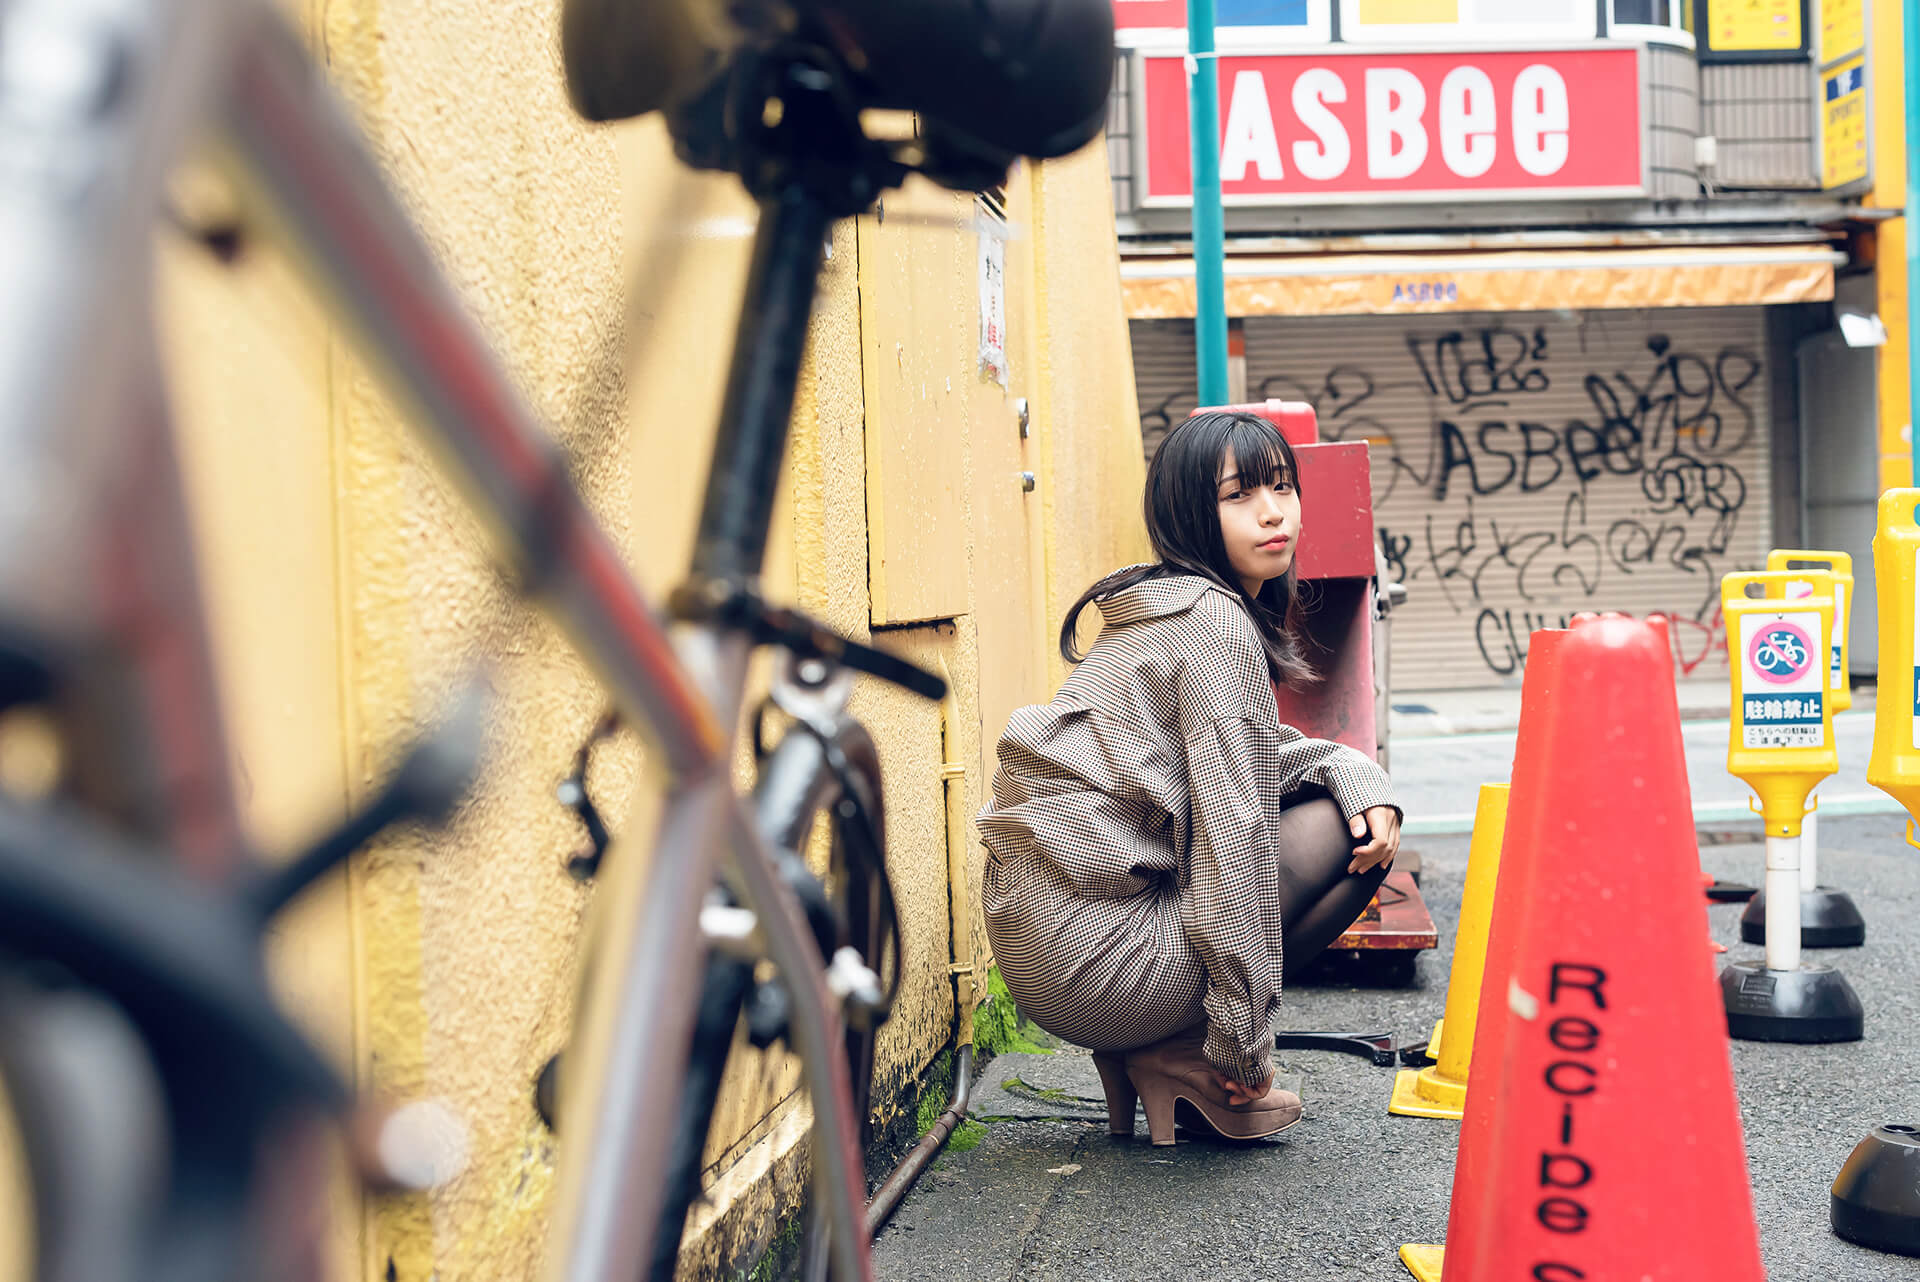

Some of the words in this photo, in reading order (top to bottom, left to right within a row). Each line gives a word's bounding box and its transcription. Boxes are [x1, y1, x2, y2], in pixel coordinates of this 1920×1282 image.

[1220, 64, 1569, 181] ASBee
[1744, 698, 1822, 719] 駐輪禁止
